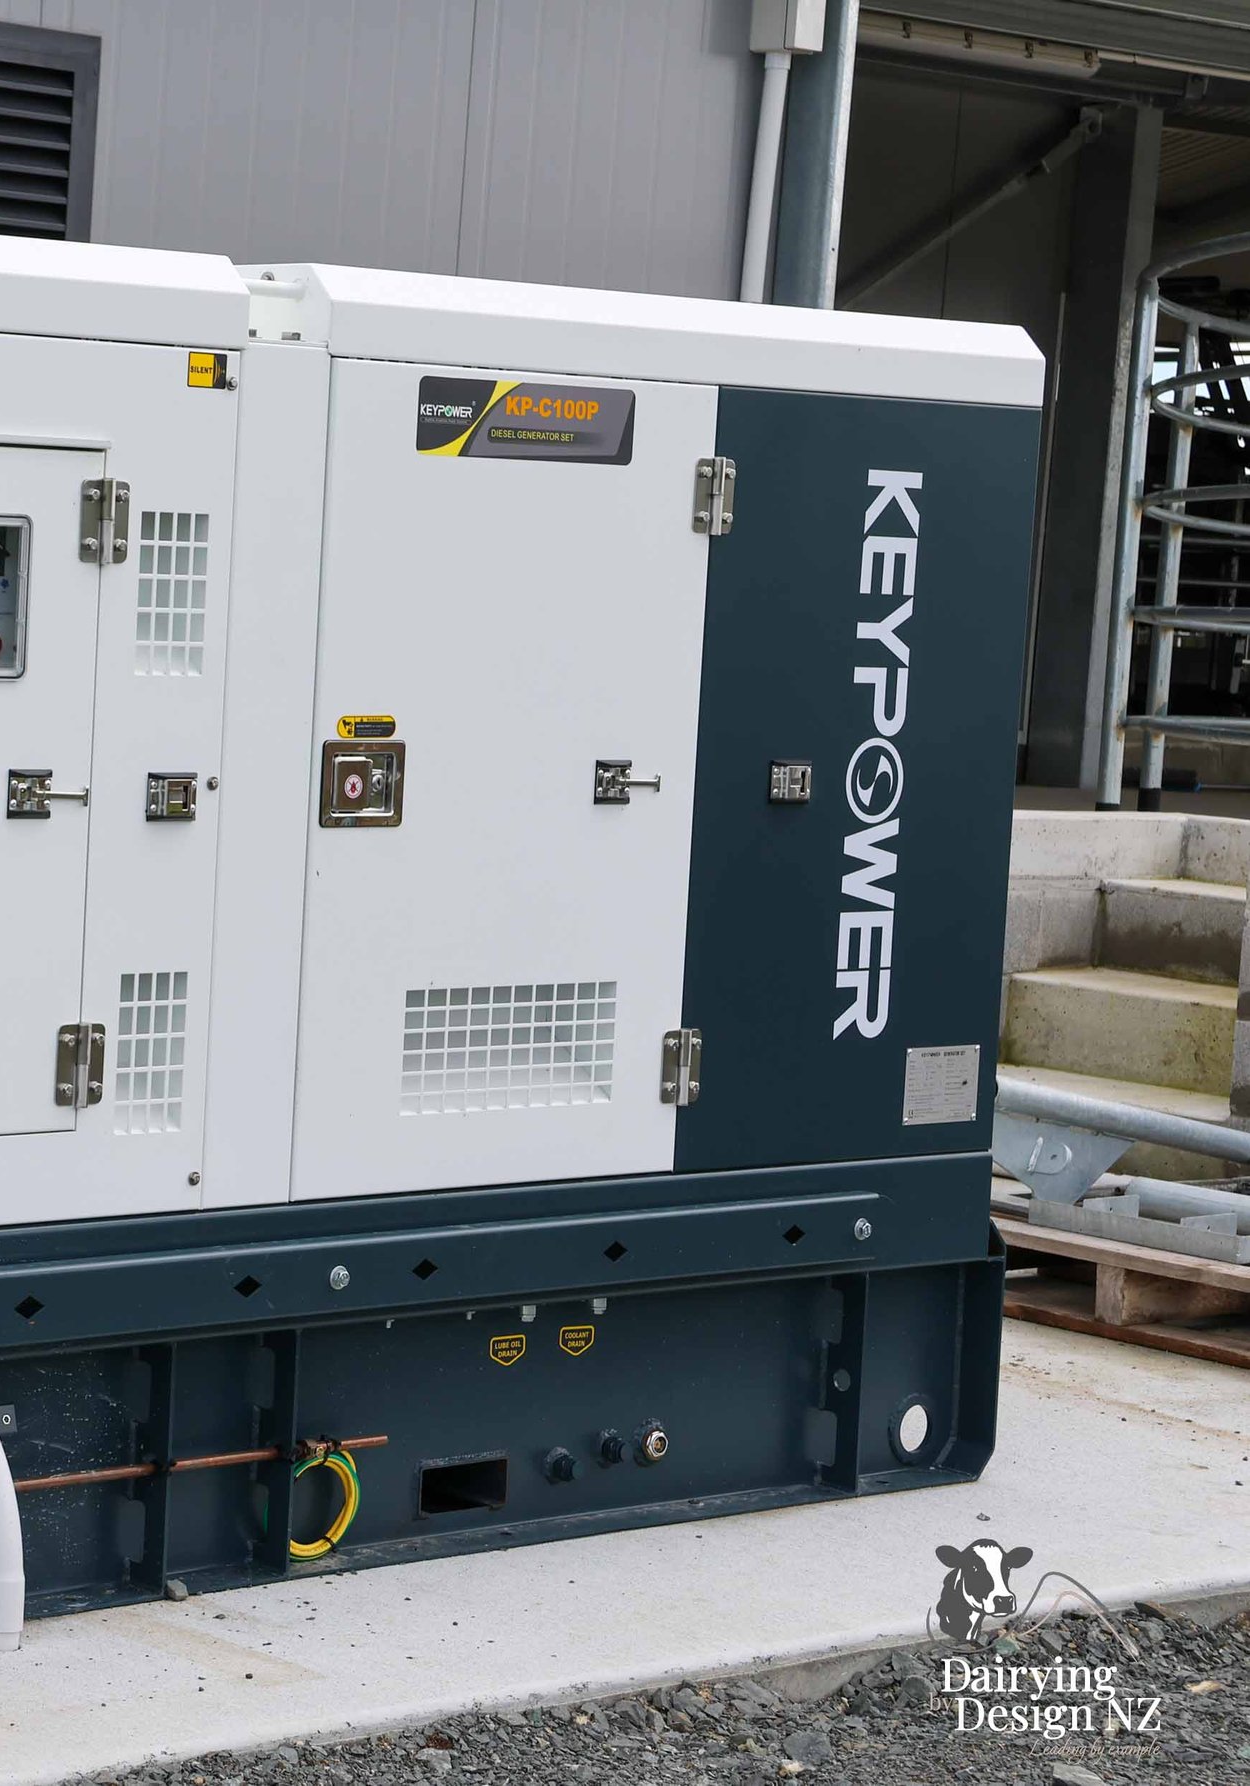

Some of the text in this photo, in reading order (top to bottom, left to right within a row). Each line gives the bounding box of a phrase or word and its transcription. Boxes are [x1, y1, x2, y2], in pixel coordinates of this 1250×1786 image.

[190, 366, 213, 374] SILENT
[420, 404, 473, 418] KEYPOWER
[505, 396, 599, 420] KP-C100P
[491, 429, 574, 441] DIESEL GENERATOR SET
[833, 469, 923, 1040] KEYPOWER
[564, 1331, 590, 1340] COOLANT
[494, 1340, 522, 1350] LUBE OIL
[567, 1340, 586, 1348] DRAIN
[497, 1350, 518, 1358] DRAIN
